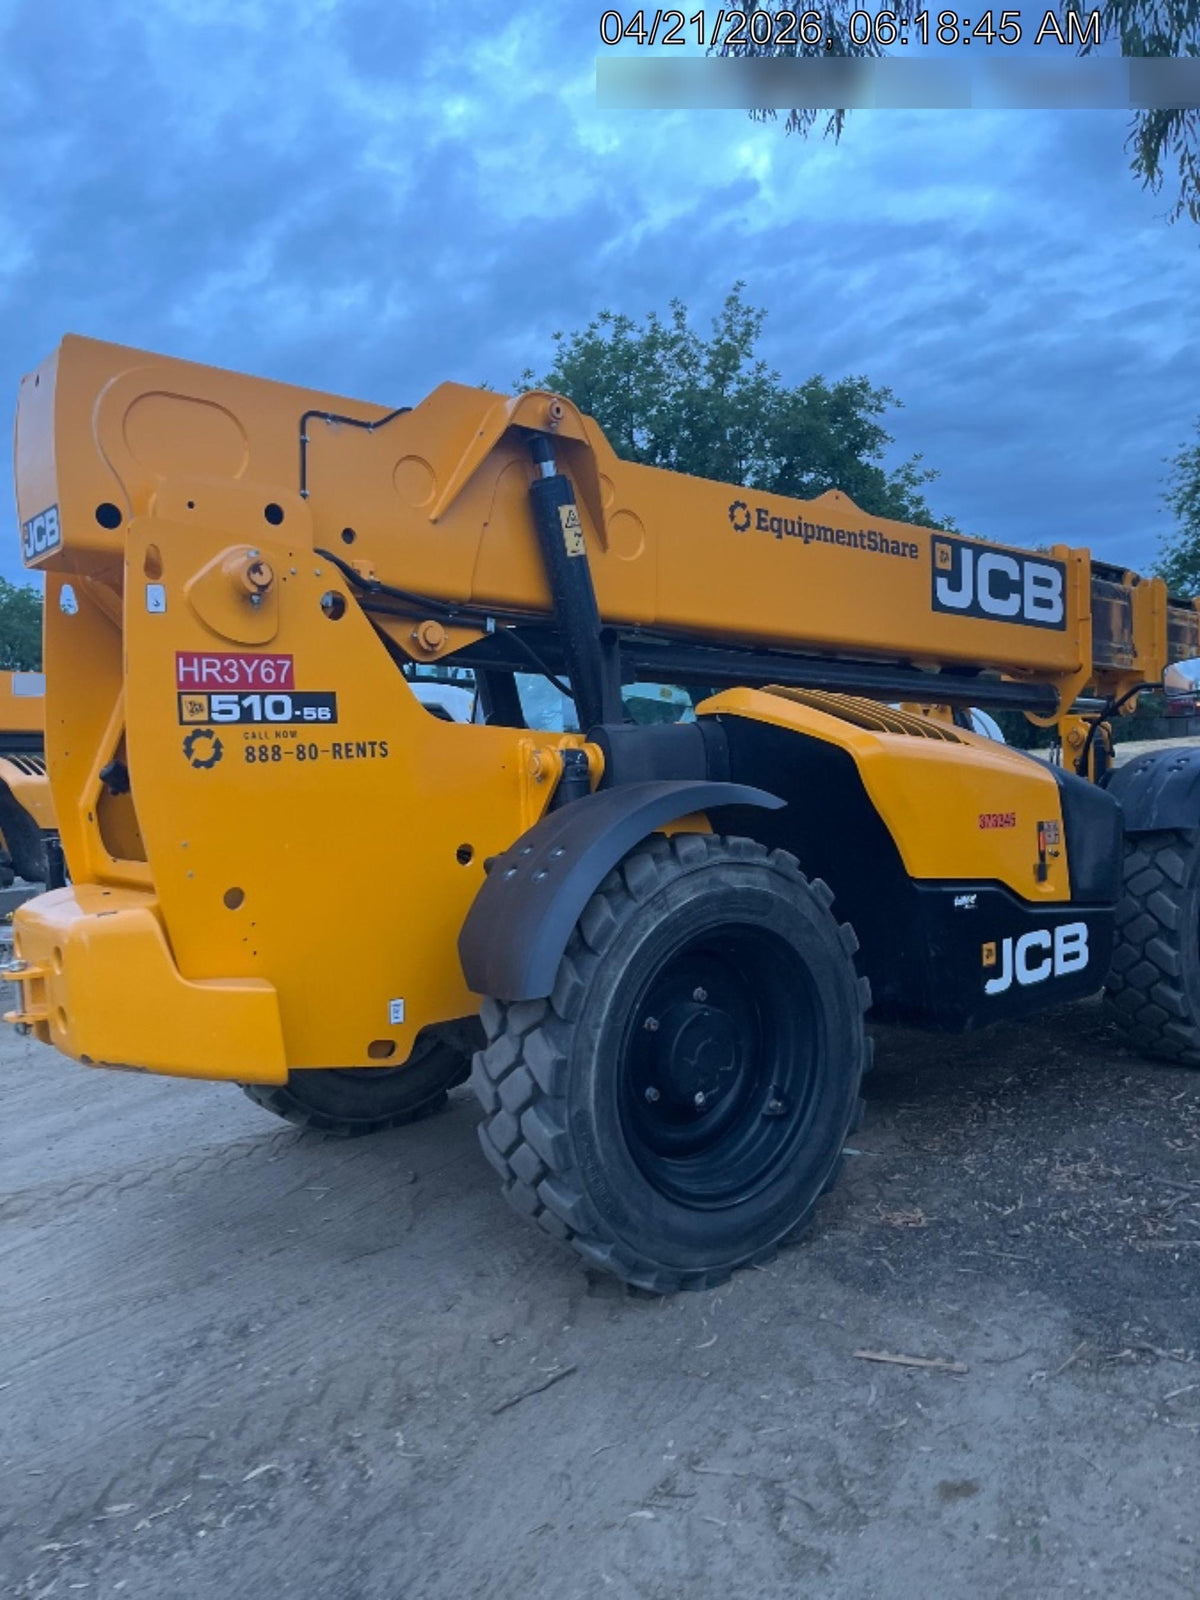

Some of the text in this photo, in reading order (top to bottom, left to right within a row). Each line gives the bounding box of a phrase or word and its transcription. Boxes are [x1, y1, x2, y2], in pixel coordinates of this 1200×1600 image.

[25, 508, 59, 557] JCB
[755, 507, 919, 559] EquipmentShare
[936, 547, 1063, 623] JCB
[178, 657, 291, 684] HR3Y67
[243, 730, 298, 741] CALL NOW
[244, 741, 389, 764] 888-80-RENTS
[984, 922, 1089, 995] JCB
